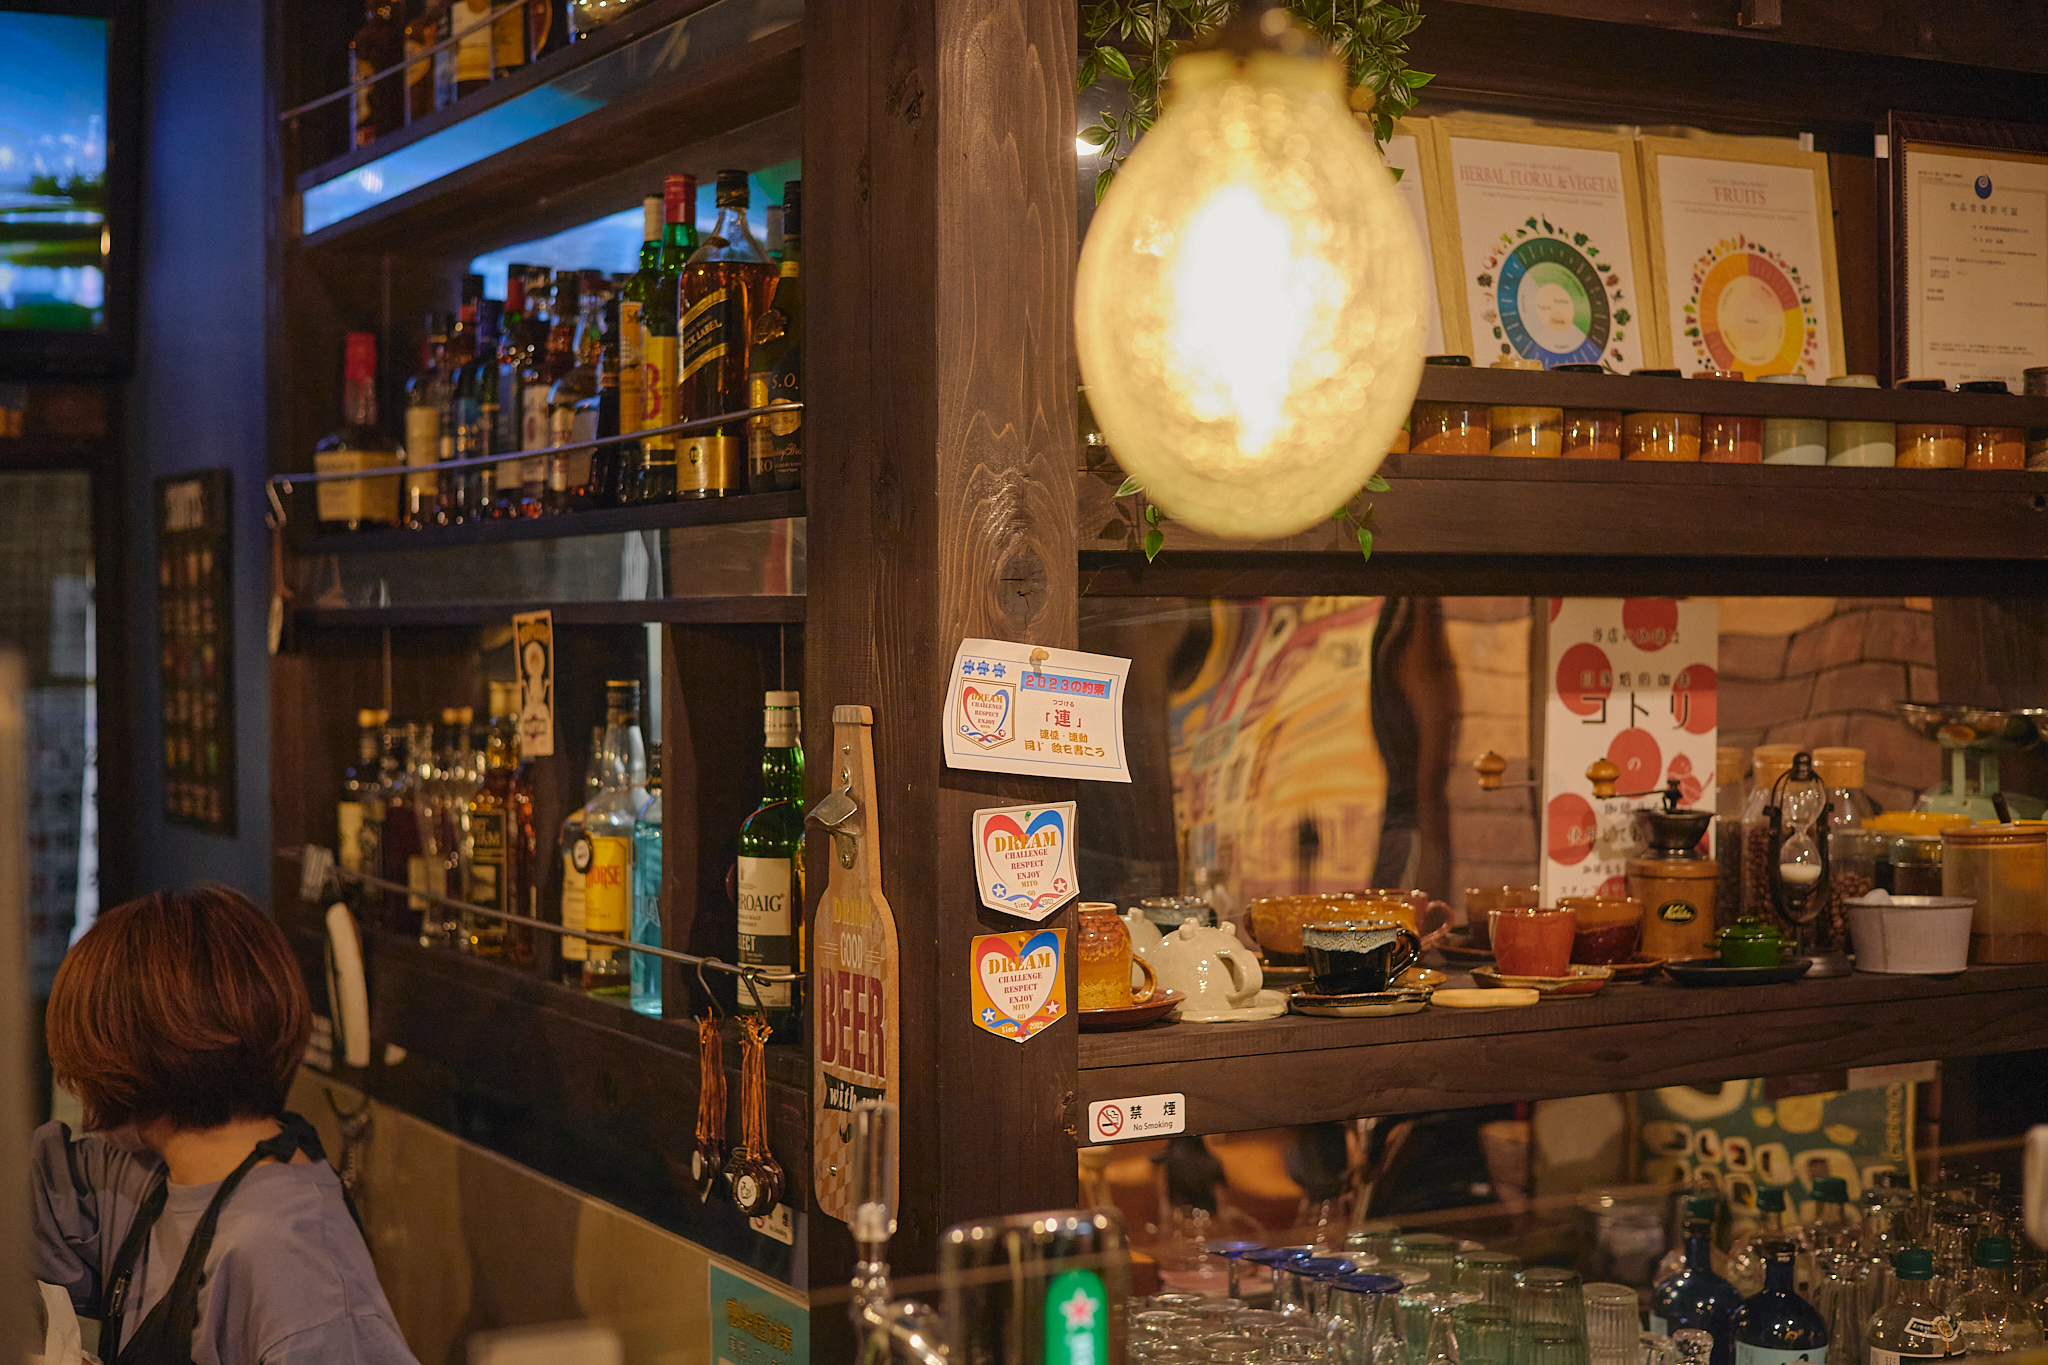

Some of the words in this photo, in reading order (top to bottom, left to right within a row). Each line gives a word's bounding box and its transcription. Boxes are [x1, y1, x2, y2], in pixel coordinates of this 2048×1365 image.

[1511, 168, 1556, 190] FLORAL
[1569, 175, 1620, 195] VEGETAL
[1714, 186, 1767, 205] FRUITS
[696, 319, 723, 341] LABEL
[1025, 674, 1106, 696] 2023の約束
[971, 692, 1003, 704] DREAM
[1052, 699, 1075, 708] つづける
[971, 701, 1003, 710] CHALLENGE
[1581, 691, 1689, 730] コトリ
[974, 710, 999, 718] RESPECT
[1045, 709, 1082, 728] 「連」
[977, 718, 996, 726] ENJOY
[1627, 756, 1642, 772] の
[994, 831, 1057, 853] DREAM
[1004, 848, 1048, 860] CHALLENGE
[1011, 859, 1044, 870] RESPECT
[1016, 870, 1041, 880] ENJOY
[1021, 880, 1038, 888] MITO
[1014, 901, 1031, 909] Since
[1041, 897, 1054, 906] 2002
[832, 896, 873, 929] DRINK
[840, 932, 864, 969] GOOD
[988, 952, 1051, 975] DREAM
[998, 972, 1043, 984] CHALLENGE
[1004, 983, 1038, 994] RESPECT
[1009, 994, 1034, 1004] ENJOY
[1012, 1003, 1030, 1011] MITO
[820, 965, 886, 1079] BEER
[1001, 1026, 1018, 1034] Since
[1029, 1021, 1044, 1030] 2002
[828, 1082, 858, 1111] with
[1130, 1101, 1176, 1120] 禁煙
[1133, 1123, 1143, 1131] No
[1144, 1121, 1173, 1131] Smoking
